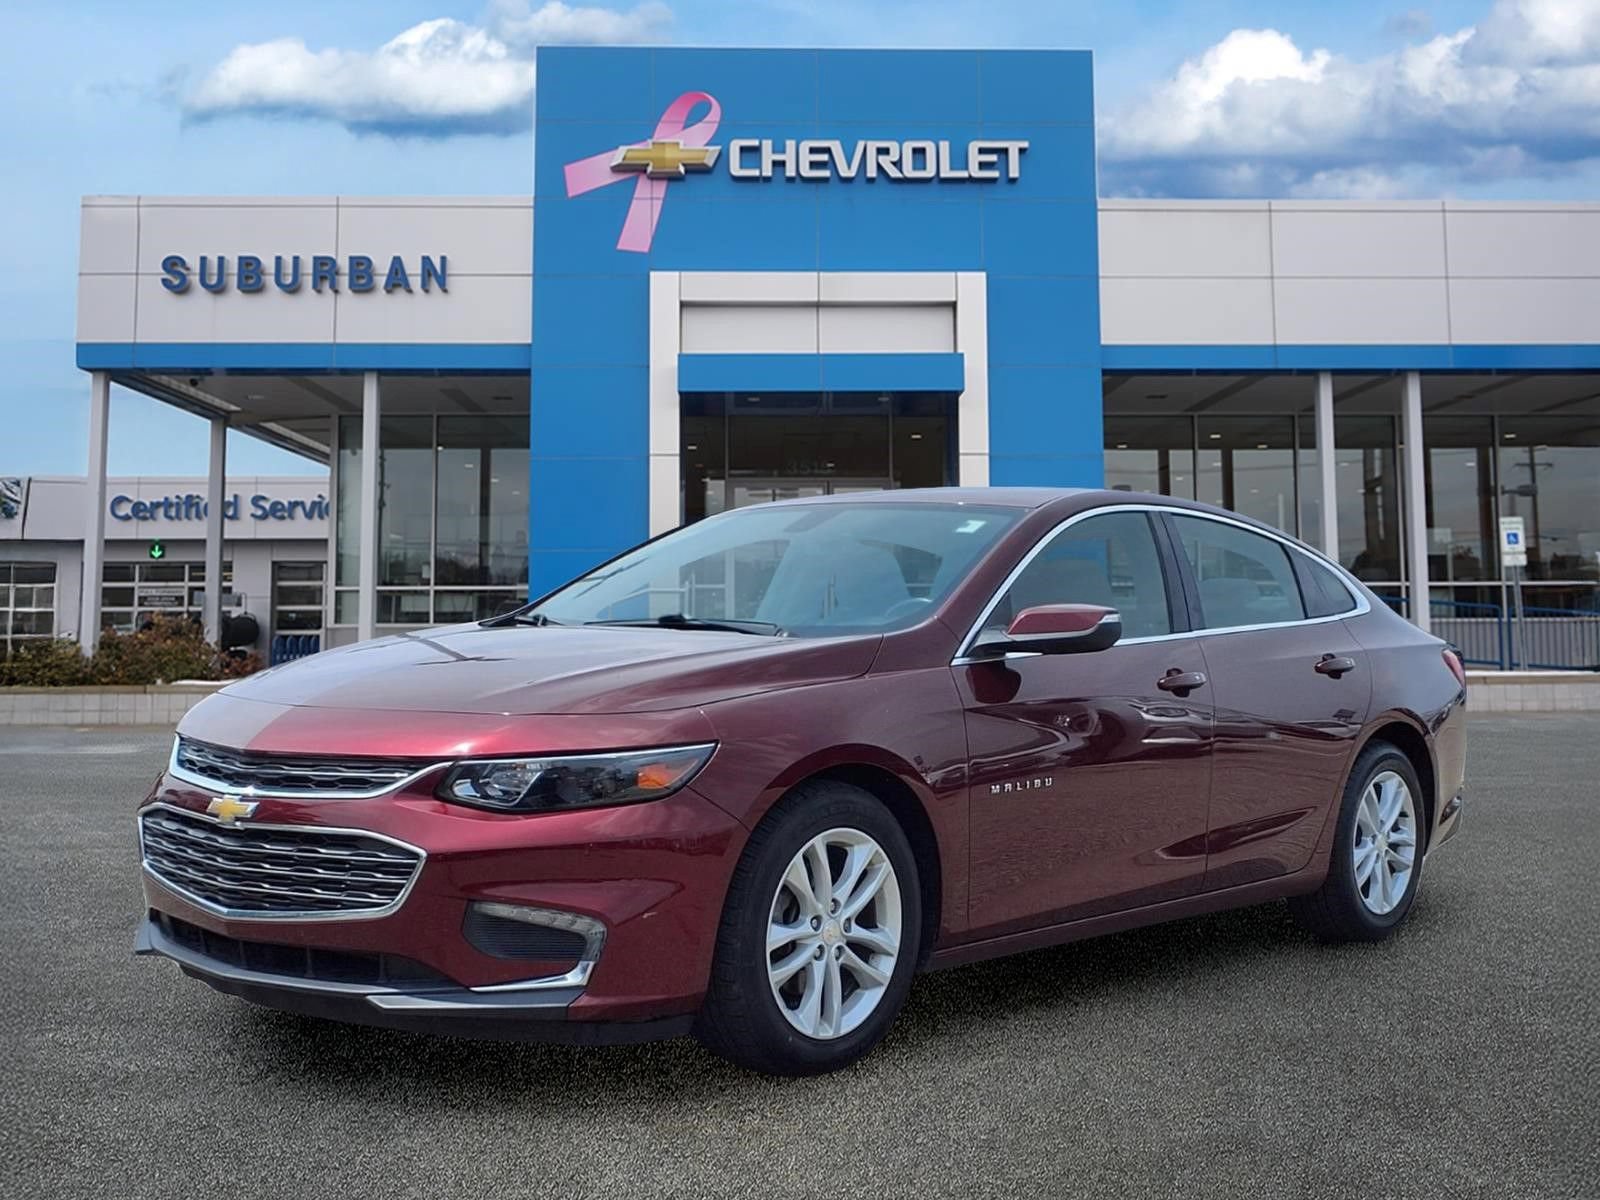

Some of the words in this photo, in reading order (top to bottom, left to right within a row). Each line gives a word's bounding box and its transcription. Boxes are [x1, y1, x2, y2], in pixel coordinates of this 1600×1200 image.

[729, 139, 1030, 182] CHEVROLET
[160, 255, 449, 295] SUBURBAN
[110, 494, 241, 521] Certifid
[250, 494, 330, 521] Servi
[991, 777, 1053, 794] MALIBU
